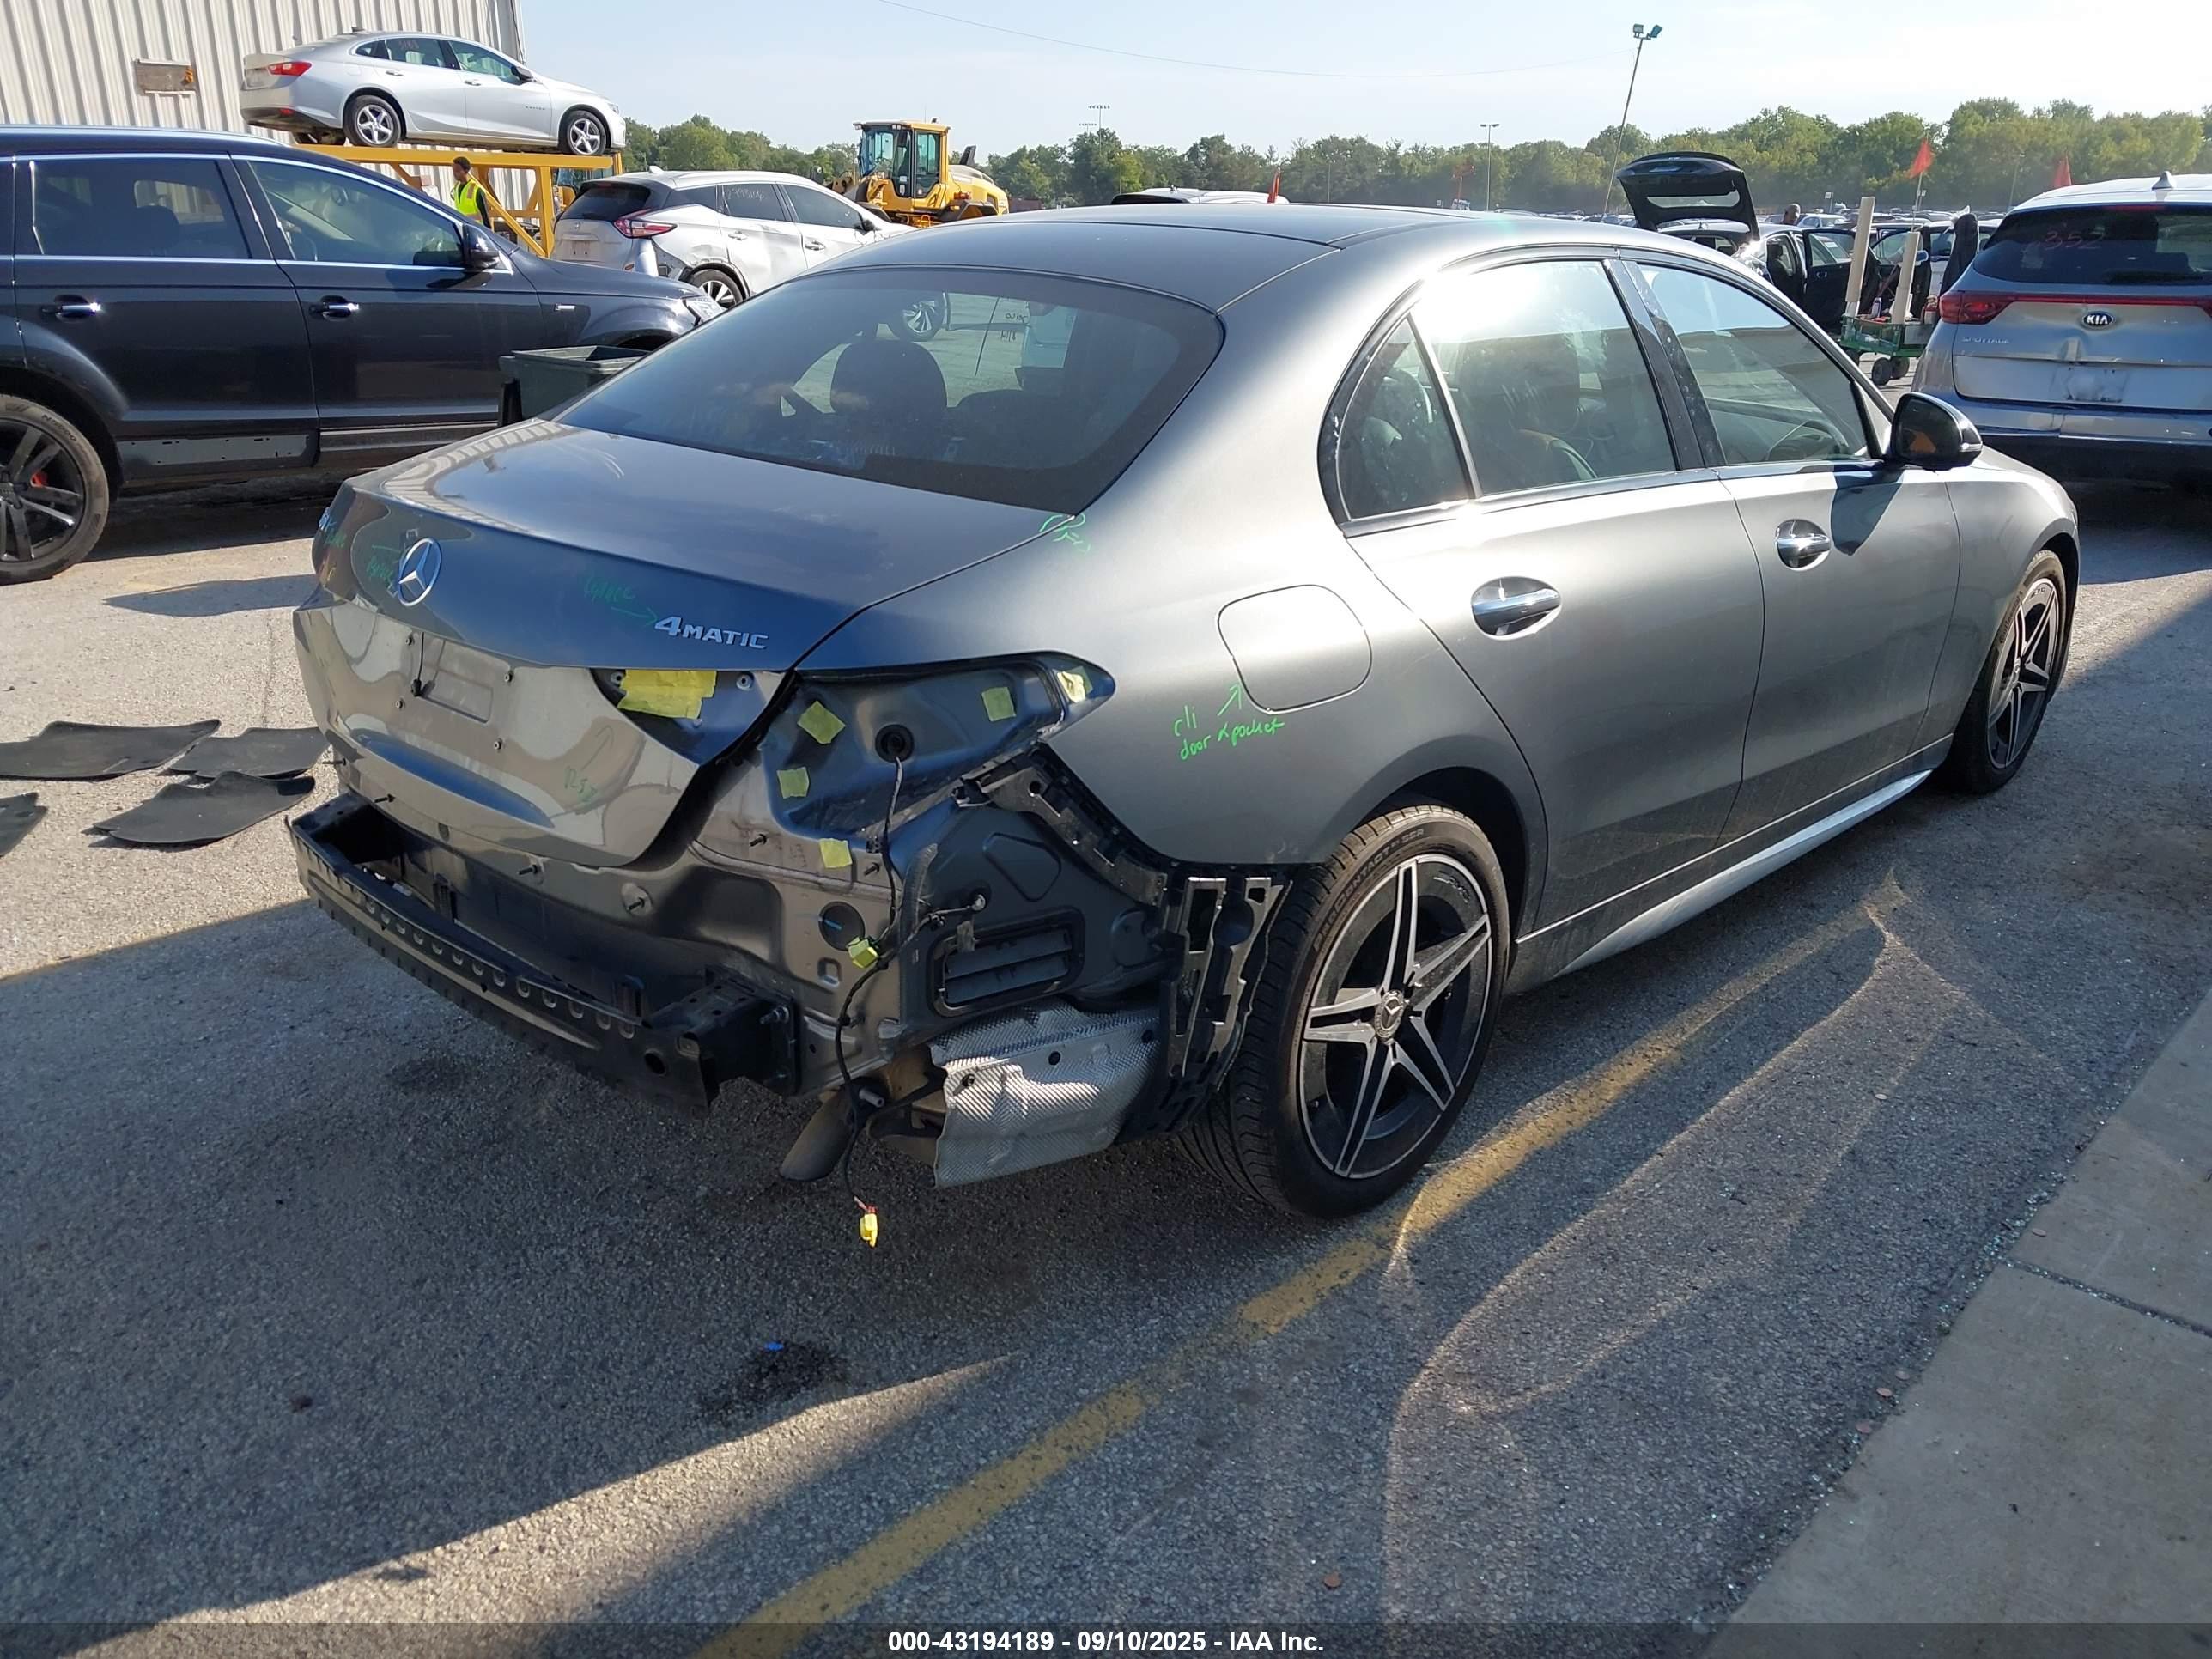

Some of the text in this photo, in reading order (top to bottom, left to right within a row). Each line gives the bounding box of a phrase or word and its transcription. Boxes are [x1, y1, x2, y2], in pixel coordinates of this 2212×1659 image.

[2086, 314, 2109, 325] KIA
[654, 616, 769, 649] 4MATIC
[1181, 736, 1212, 760] door
